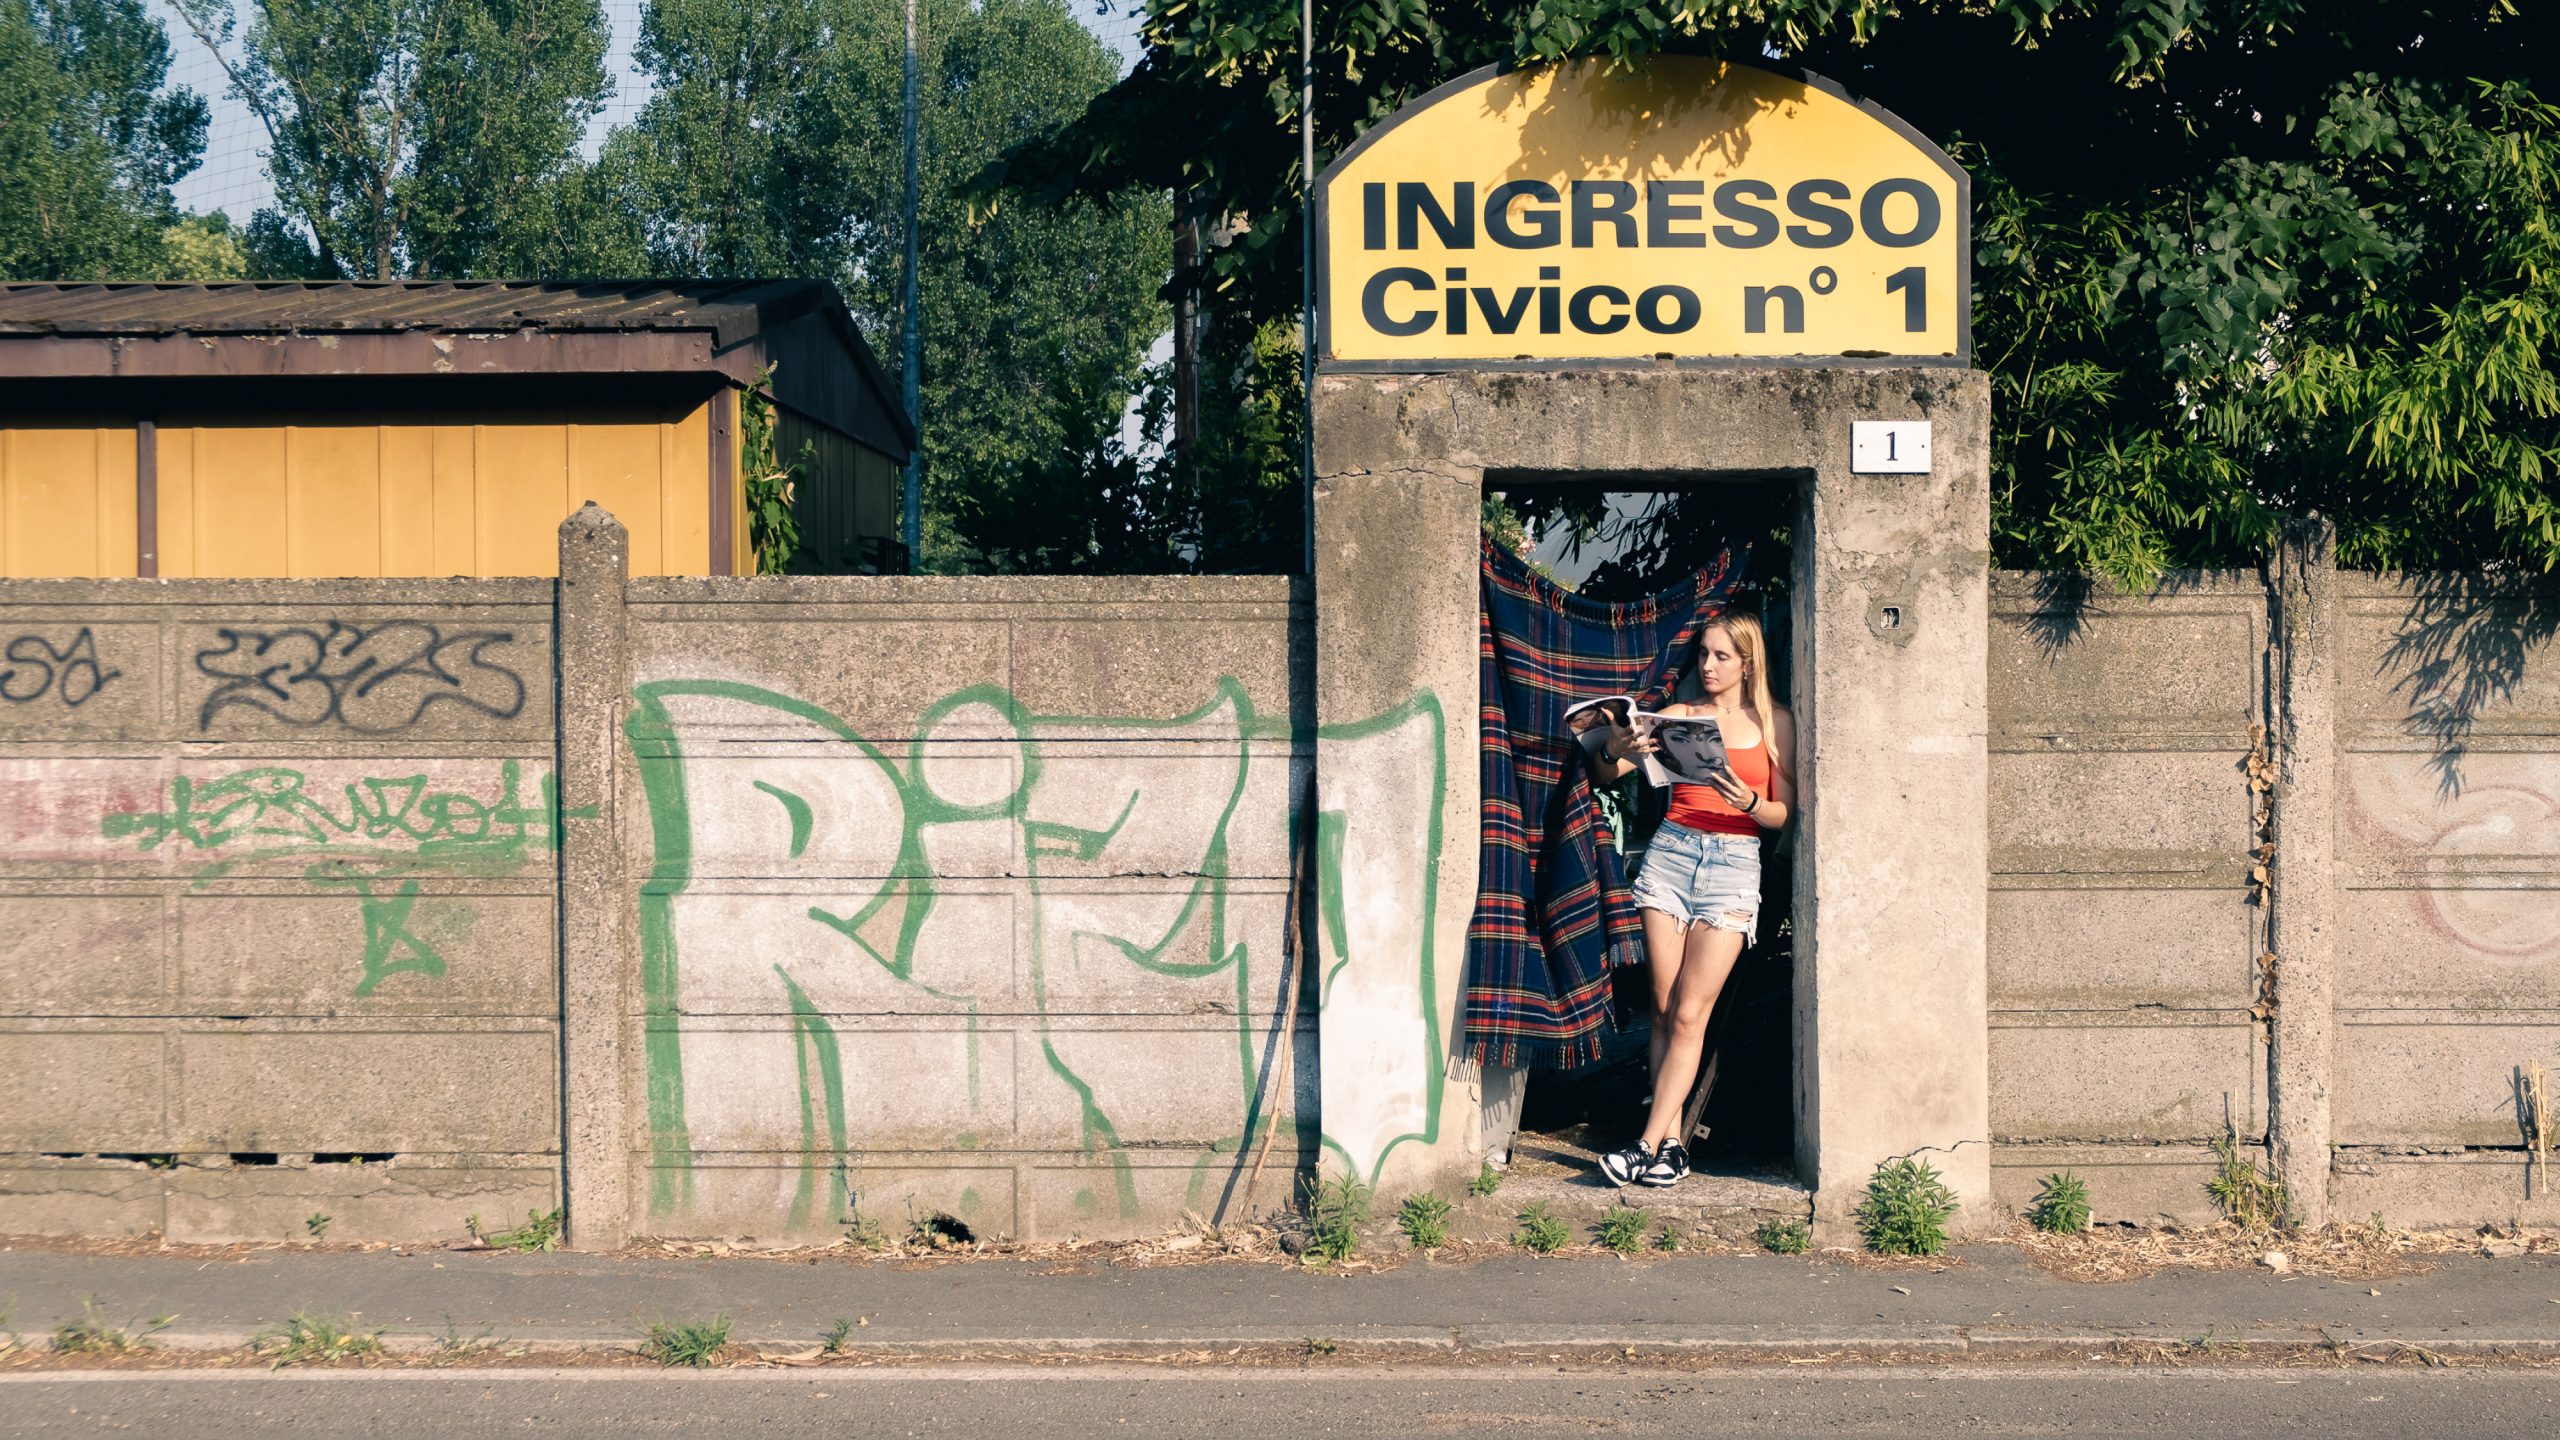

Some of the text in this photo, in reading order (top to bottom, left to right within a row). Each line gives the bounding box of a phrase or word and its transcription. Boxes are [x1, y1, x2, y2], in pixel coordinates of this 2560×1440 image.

[1362, 177, 1942, 251] INGRESSO
[1361, 264, 1928, 337] Civico n° 1
[1885, 430, 1899, 462] 1
